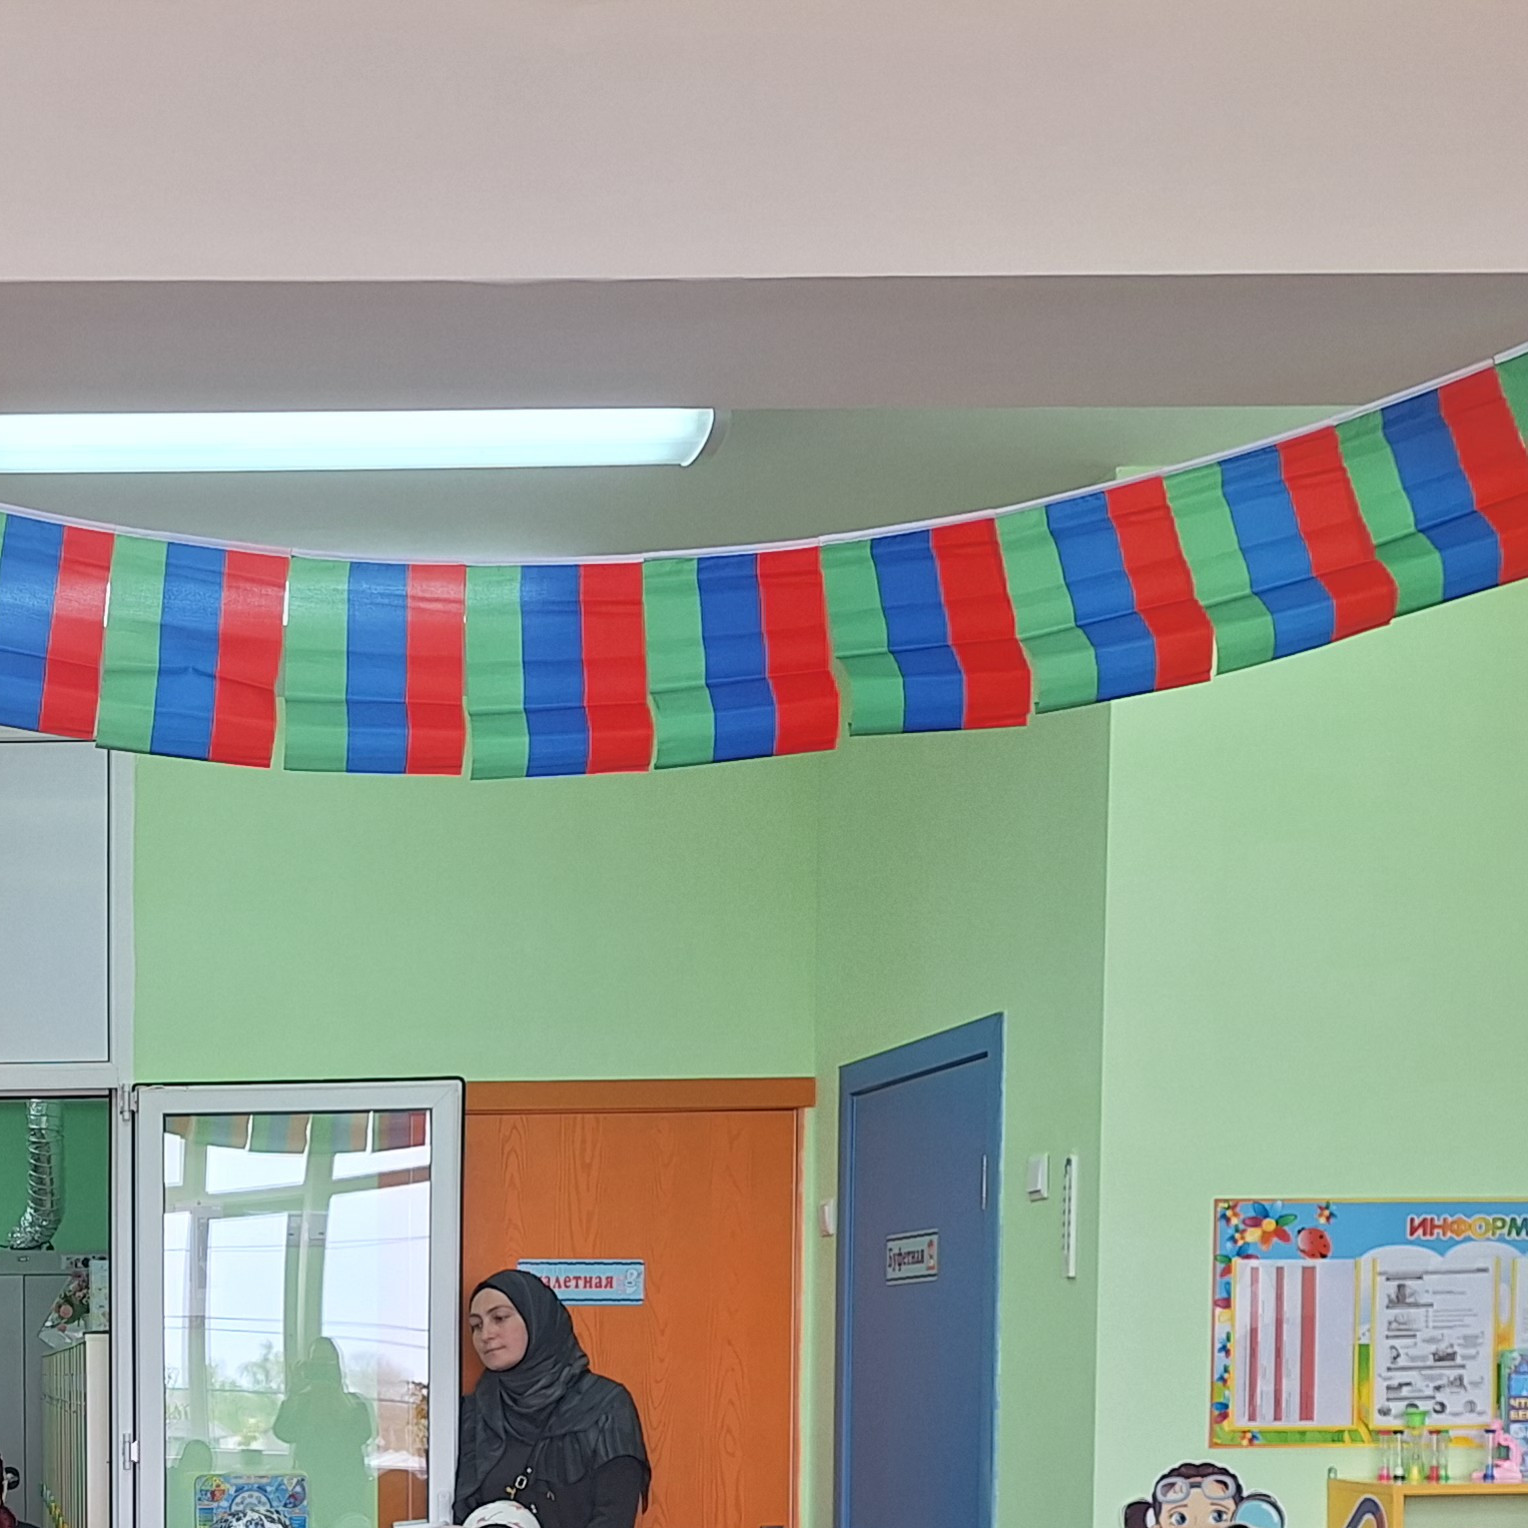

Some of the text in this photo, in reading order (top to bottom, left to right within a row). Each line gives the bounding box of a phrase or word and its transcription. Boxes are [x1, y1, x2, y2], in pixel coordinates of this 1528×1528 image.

[1408, 1215, 1528, 1239] ИНФОРМ
[888, 1247, 924, 1272] Буфетная
[538, 1274, 614, 1290] алетная
